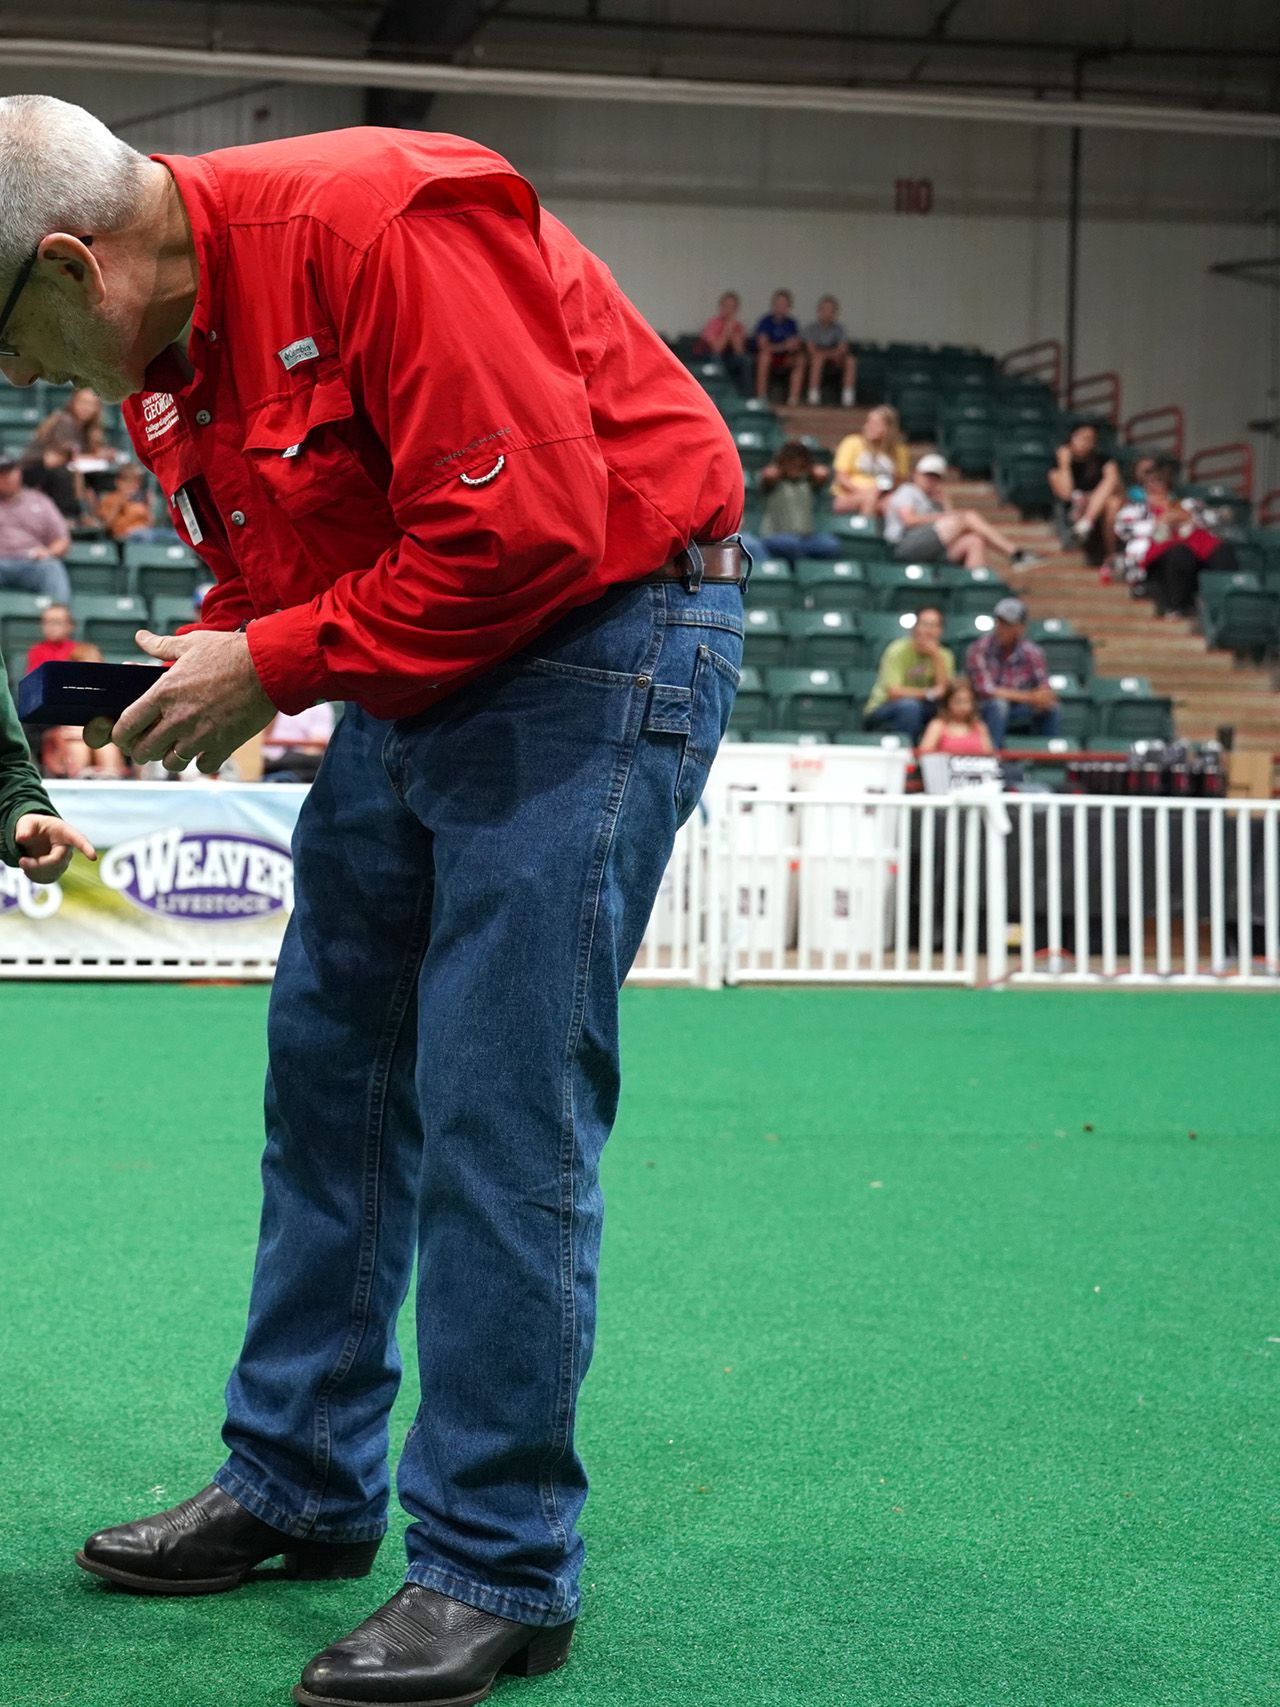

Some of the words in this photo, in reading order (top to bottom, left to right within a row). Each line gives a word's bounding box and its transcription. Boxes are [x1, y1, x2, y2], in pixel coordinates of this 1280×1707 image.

[895, 178, 934, 215] 110
[144, 393, 174, 422] GEORGIA
[99, 826, 295, 912] WEAVER
[156, 893, 270, 914] LIVESTOCK
